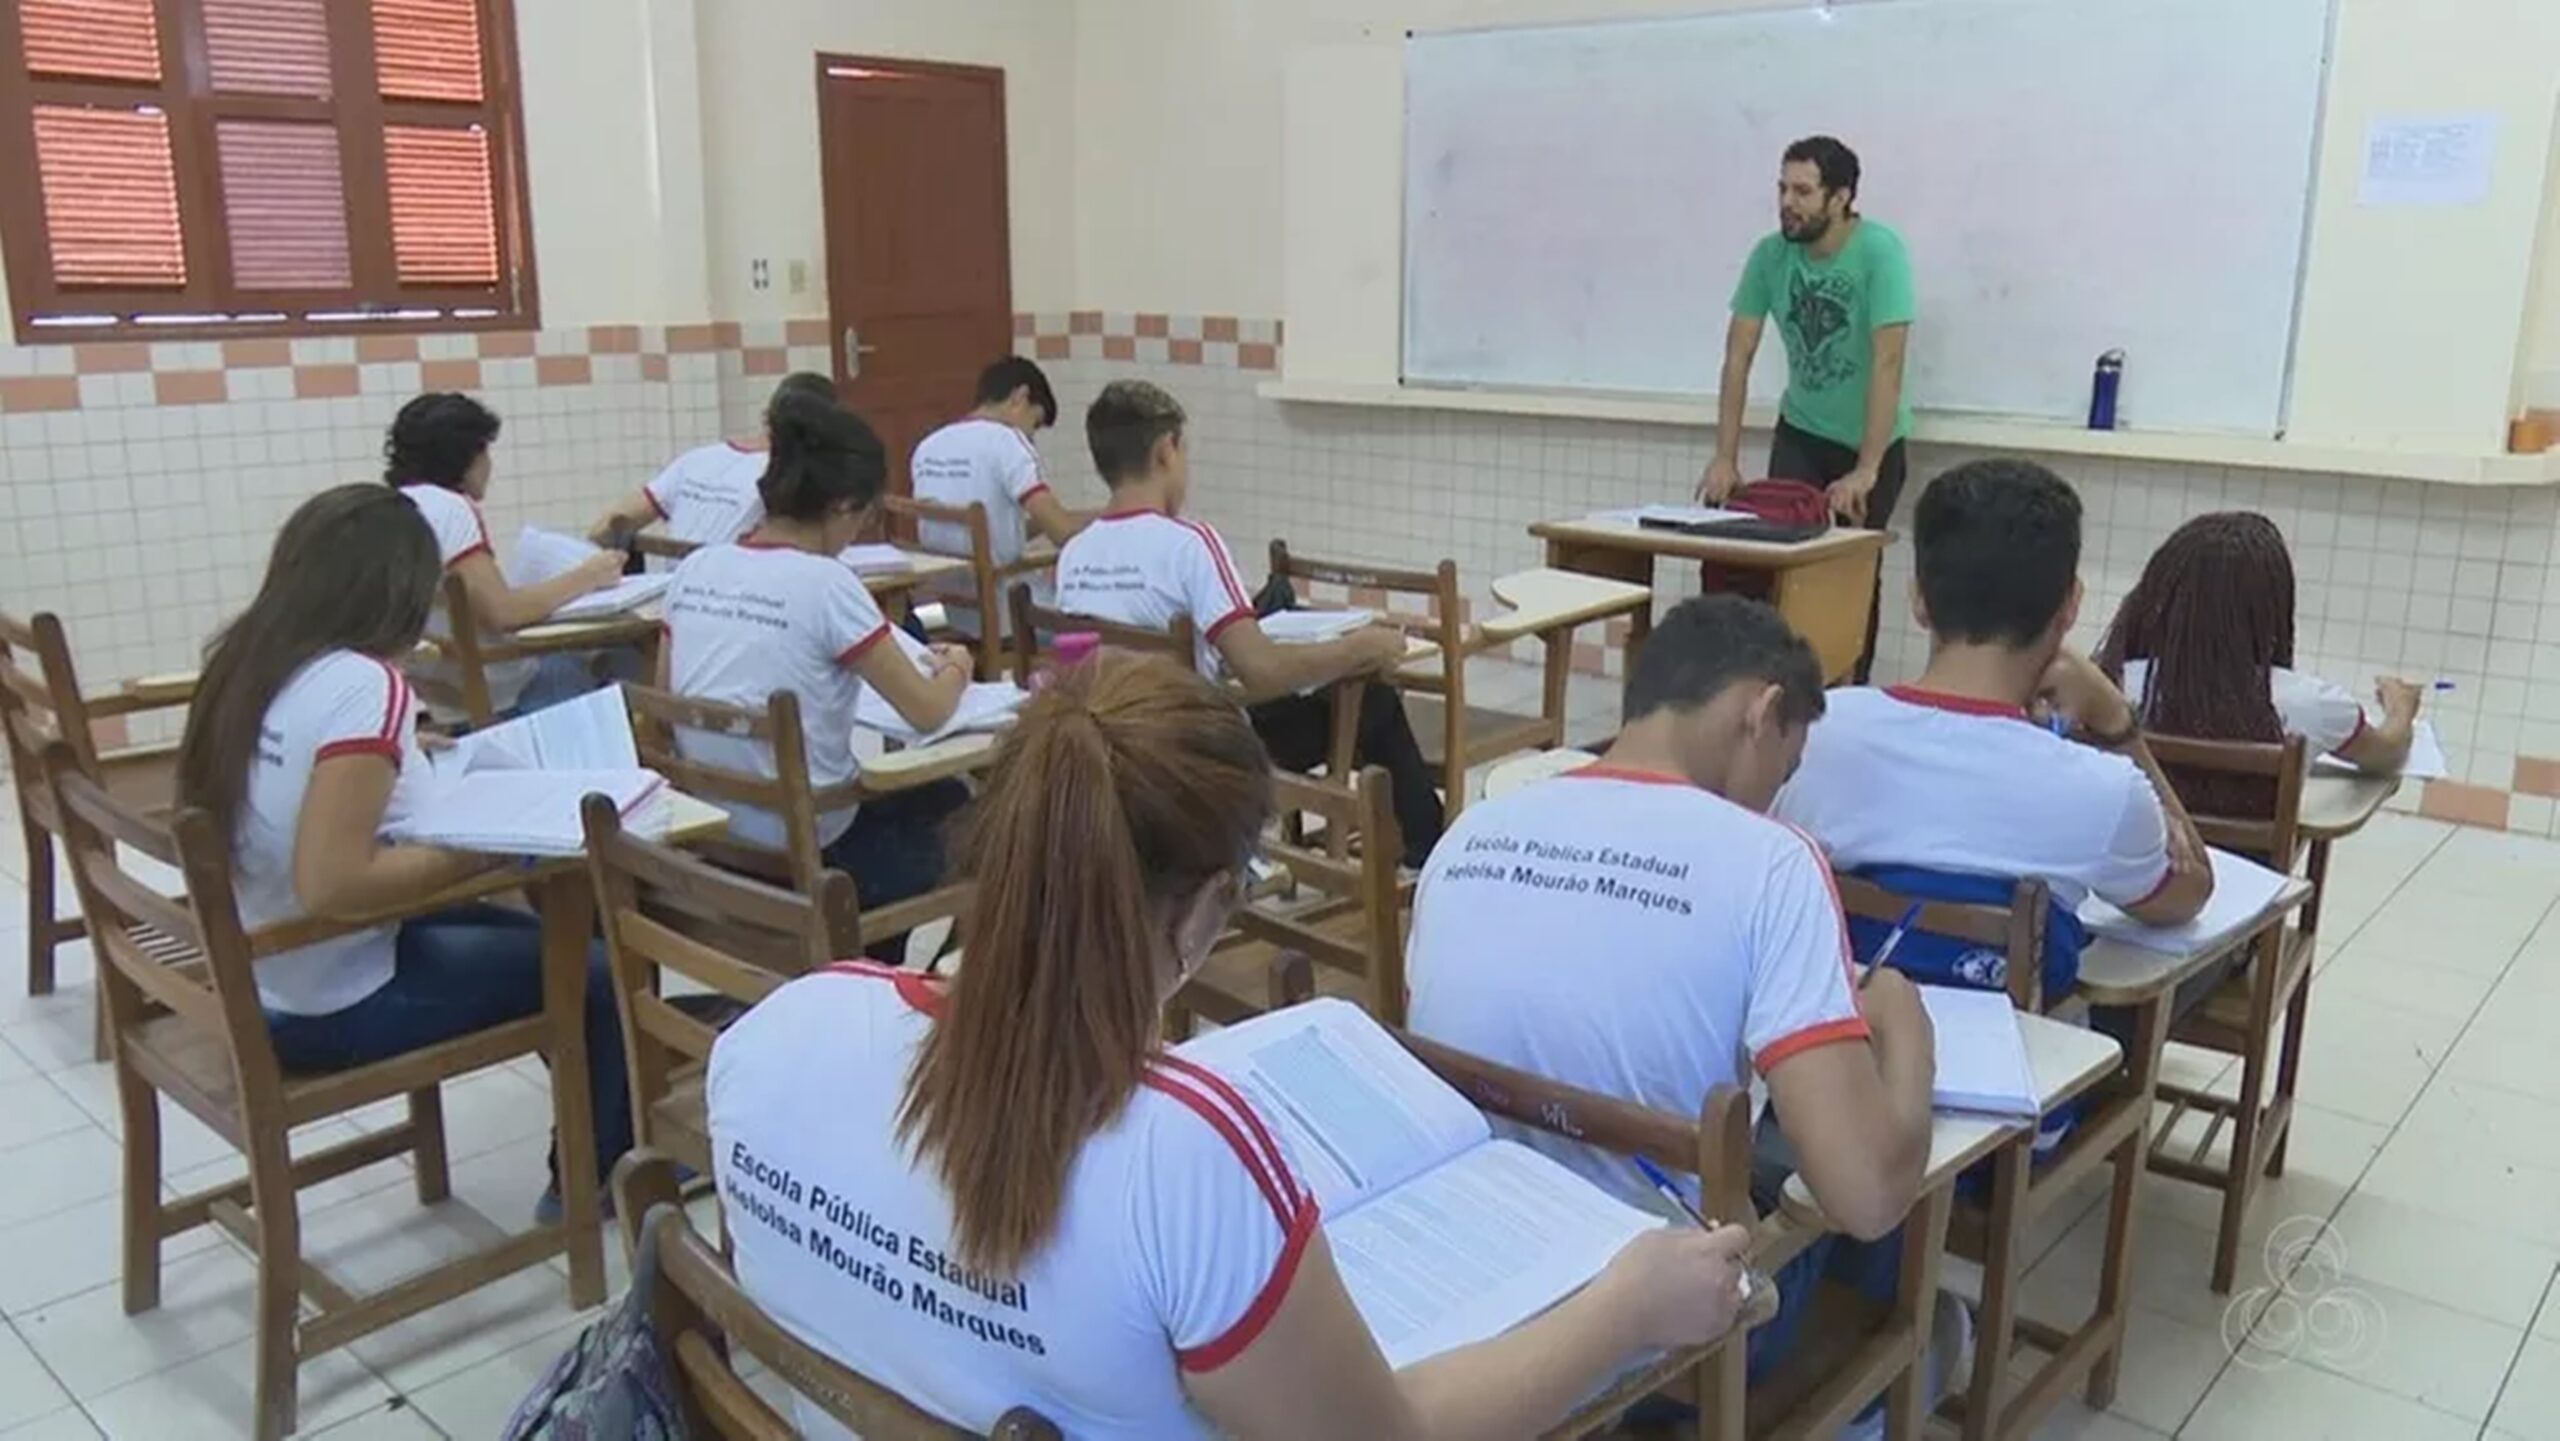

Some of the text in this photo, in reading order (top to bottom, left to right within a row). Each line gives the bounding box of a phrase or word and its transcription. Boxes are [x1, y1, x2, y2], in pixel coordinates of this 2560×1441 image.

[1465, 834, 1690, 880] Escola Pública Estadual
[1511, 865, 1590, 893] Mourão
[1594, 876, 1694, 916] Marques
[731, 1141, 1028, 1312] Escola Pública Estadual
[809, 1228, 904, 1301] Mourão
[912, 1281, 1047, 1356] Marques
